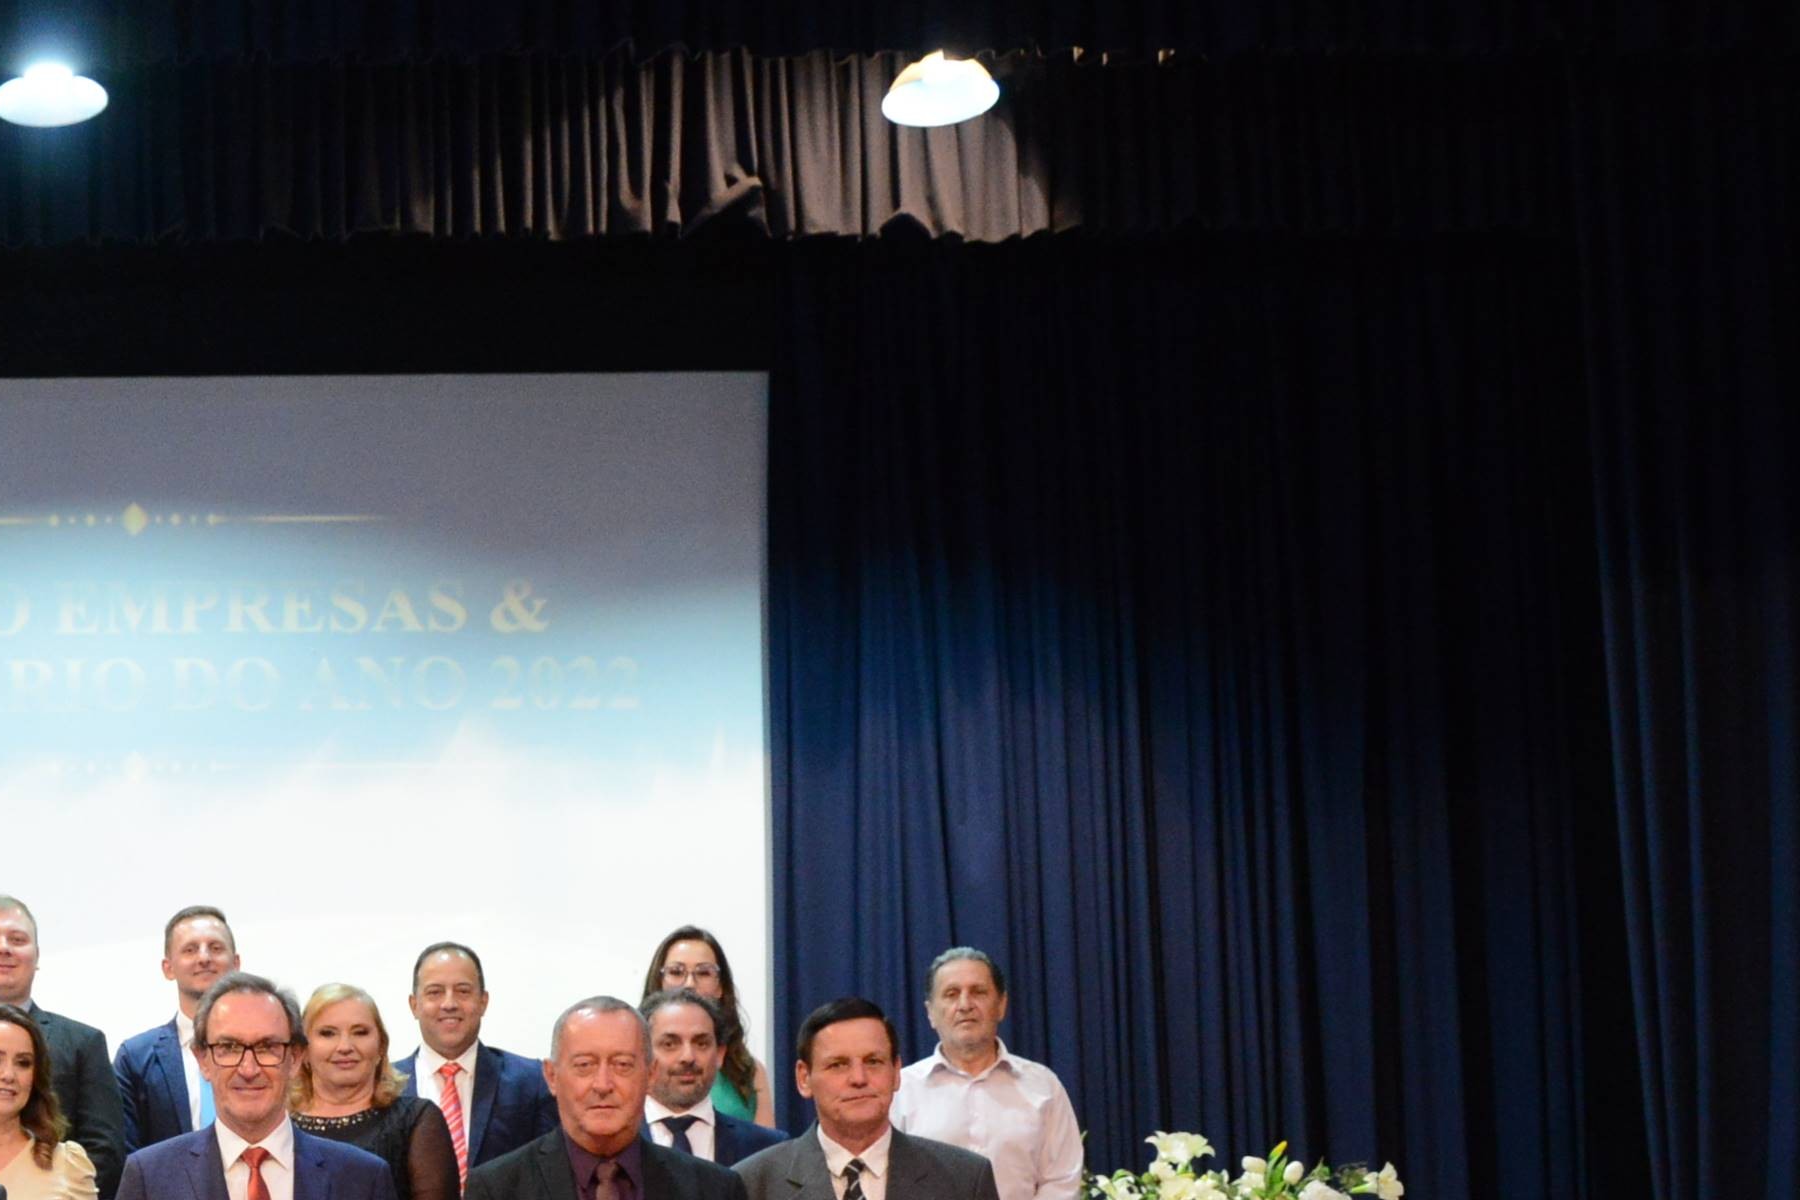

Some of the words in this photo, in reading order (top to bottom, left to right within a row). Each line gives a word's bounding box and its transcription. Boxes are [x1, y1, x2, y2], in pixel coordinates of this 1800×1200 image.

[54, 577, 467, 635] EMPRESAS
[490, 575, 549, 633] &
[168, 655, 281, 712] DO
[297, 652, 468, 711] ANO
[490, 653, 641, 711] 2022
